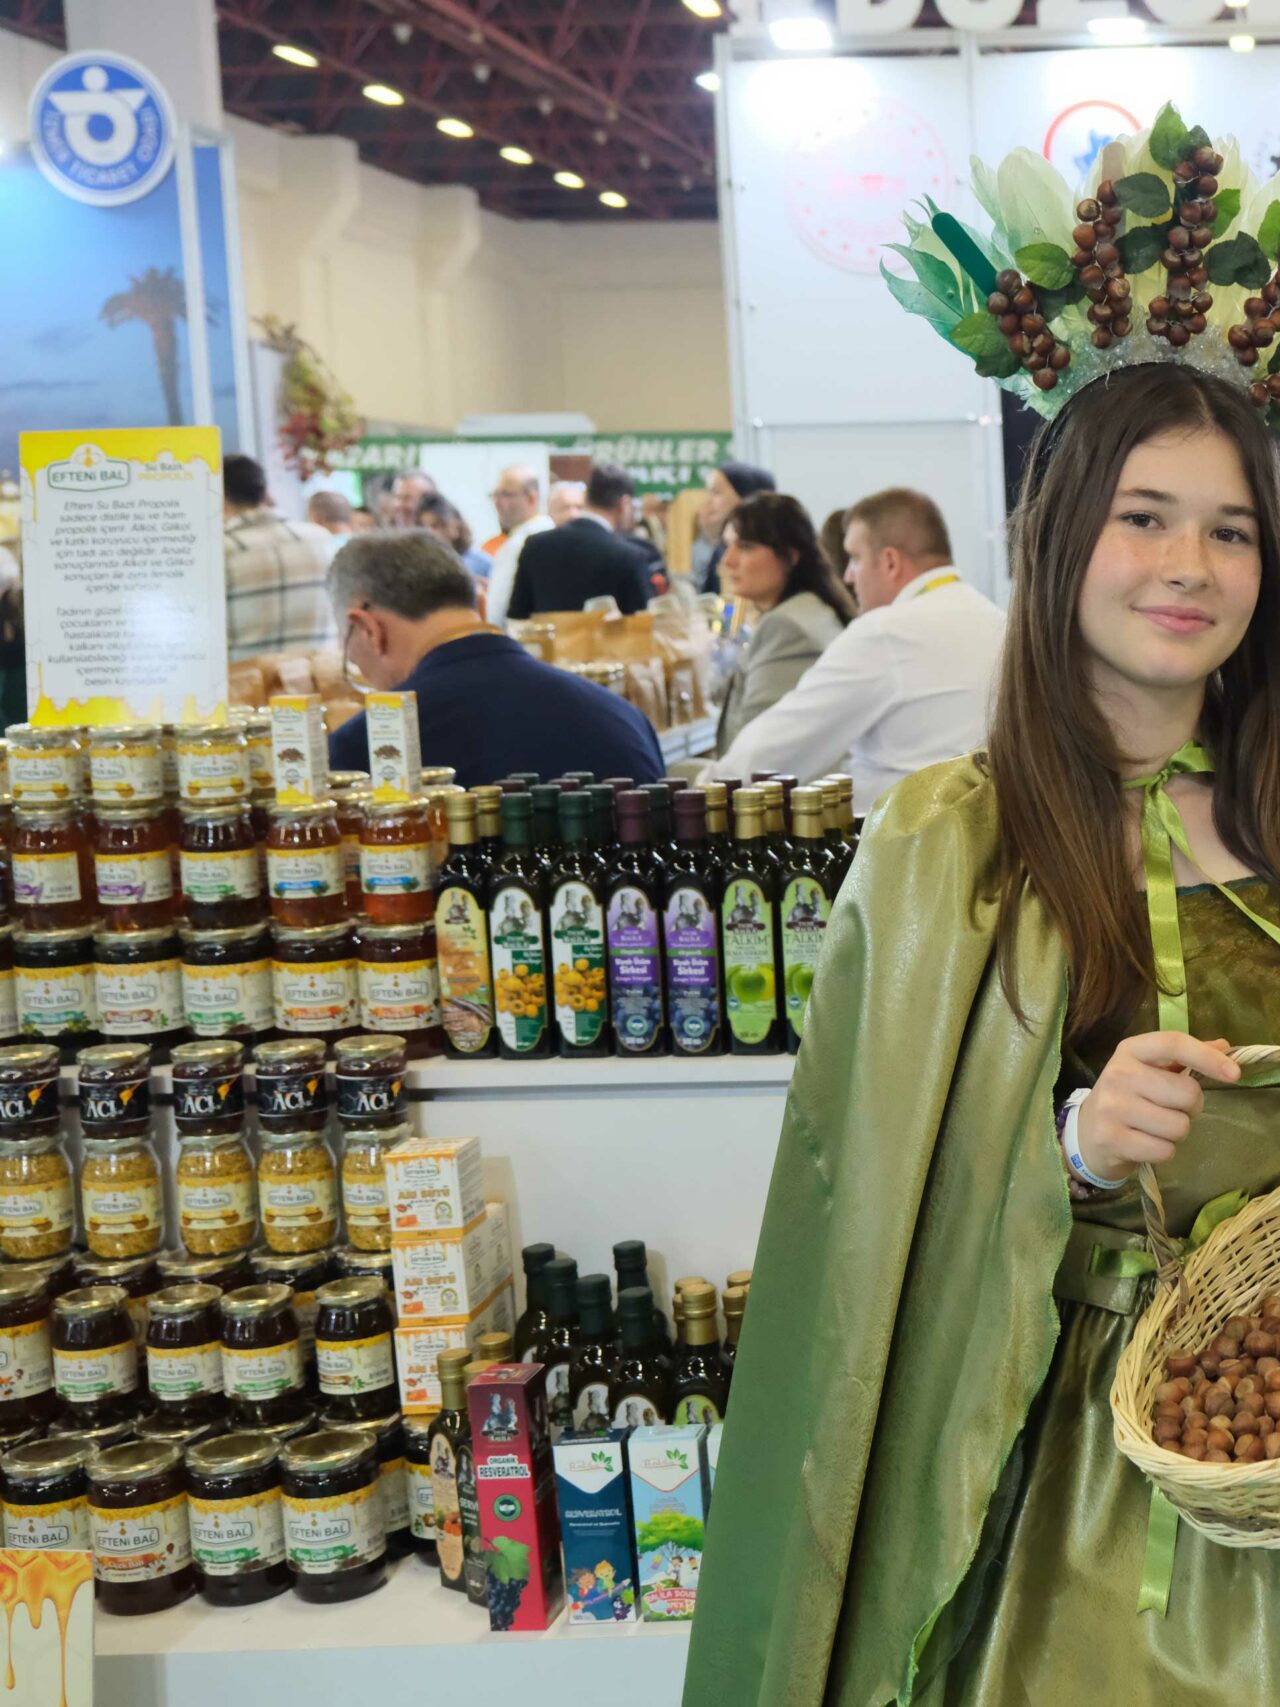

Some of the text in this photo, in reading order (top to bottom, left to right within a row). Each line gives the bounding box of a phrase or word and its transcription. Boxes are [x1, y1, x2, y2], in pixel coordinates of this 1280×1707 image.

[100, 469, 125, 481] BAL
[479, 1465, 529, 1478] RESVERATROL
[226, 1528, 249, 1539] BAL
[324, 1524, 347, 1537] BAL
[41, 1532, 65, 1544] BAL
[133, 1535, 155, 1546] BAL
